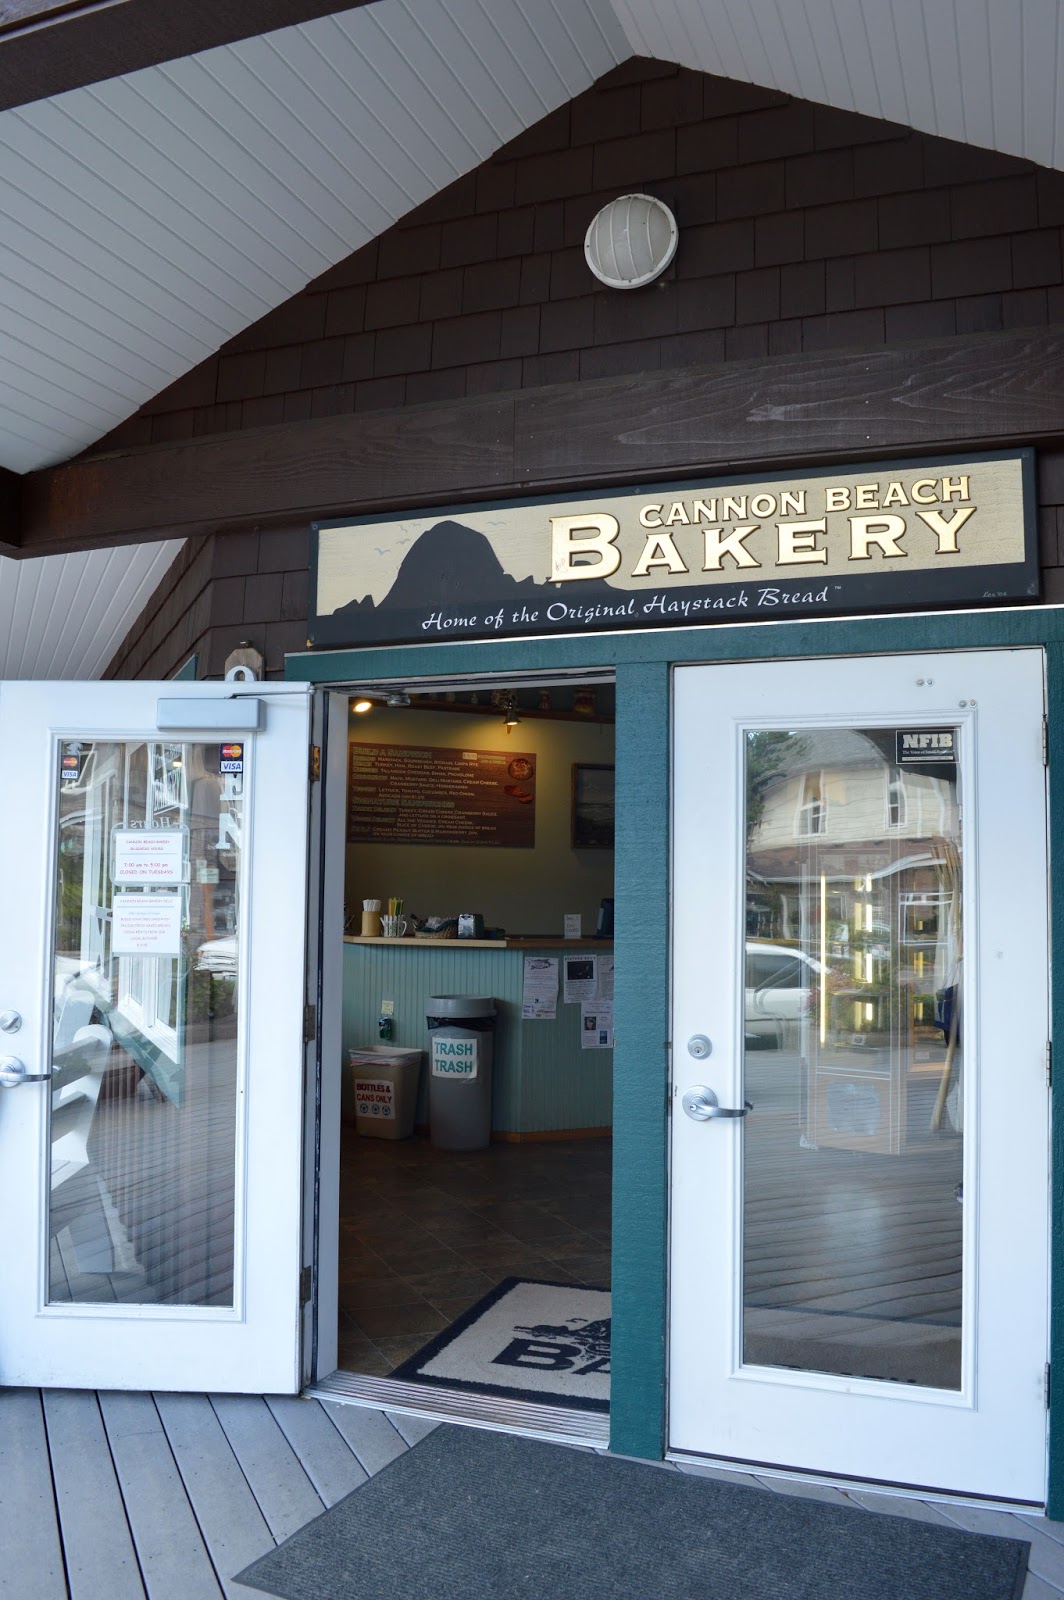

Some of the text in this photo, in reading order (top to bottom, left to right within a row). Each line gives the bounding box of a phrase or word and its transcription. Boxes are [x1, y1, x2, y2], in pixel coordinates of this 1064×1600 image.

[639, 475, 970, 528] CANNON BEACH
[548, 506, 978, 583] BAKERY
[422, 612, 477, 630] Home
[484, 608, 504, 629] of
[512, 606, 538, 623] the
[546, 598, 634, 623] Original
[643, 590, 748, 616] Haystack
[758, 586, 828, 607] Bread
[902, 734, 952, 748] NFIB
[434, 1042, 472, 1056] TRASH
[434, 1059, 472, 1073] TRASH
[357, 1084, 385, 1093] BOTTLES
